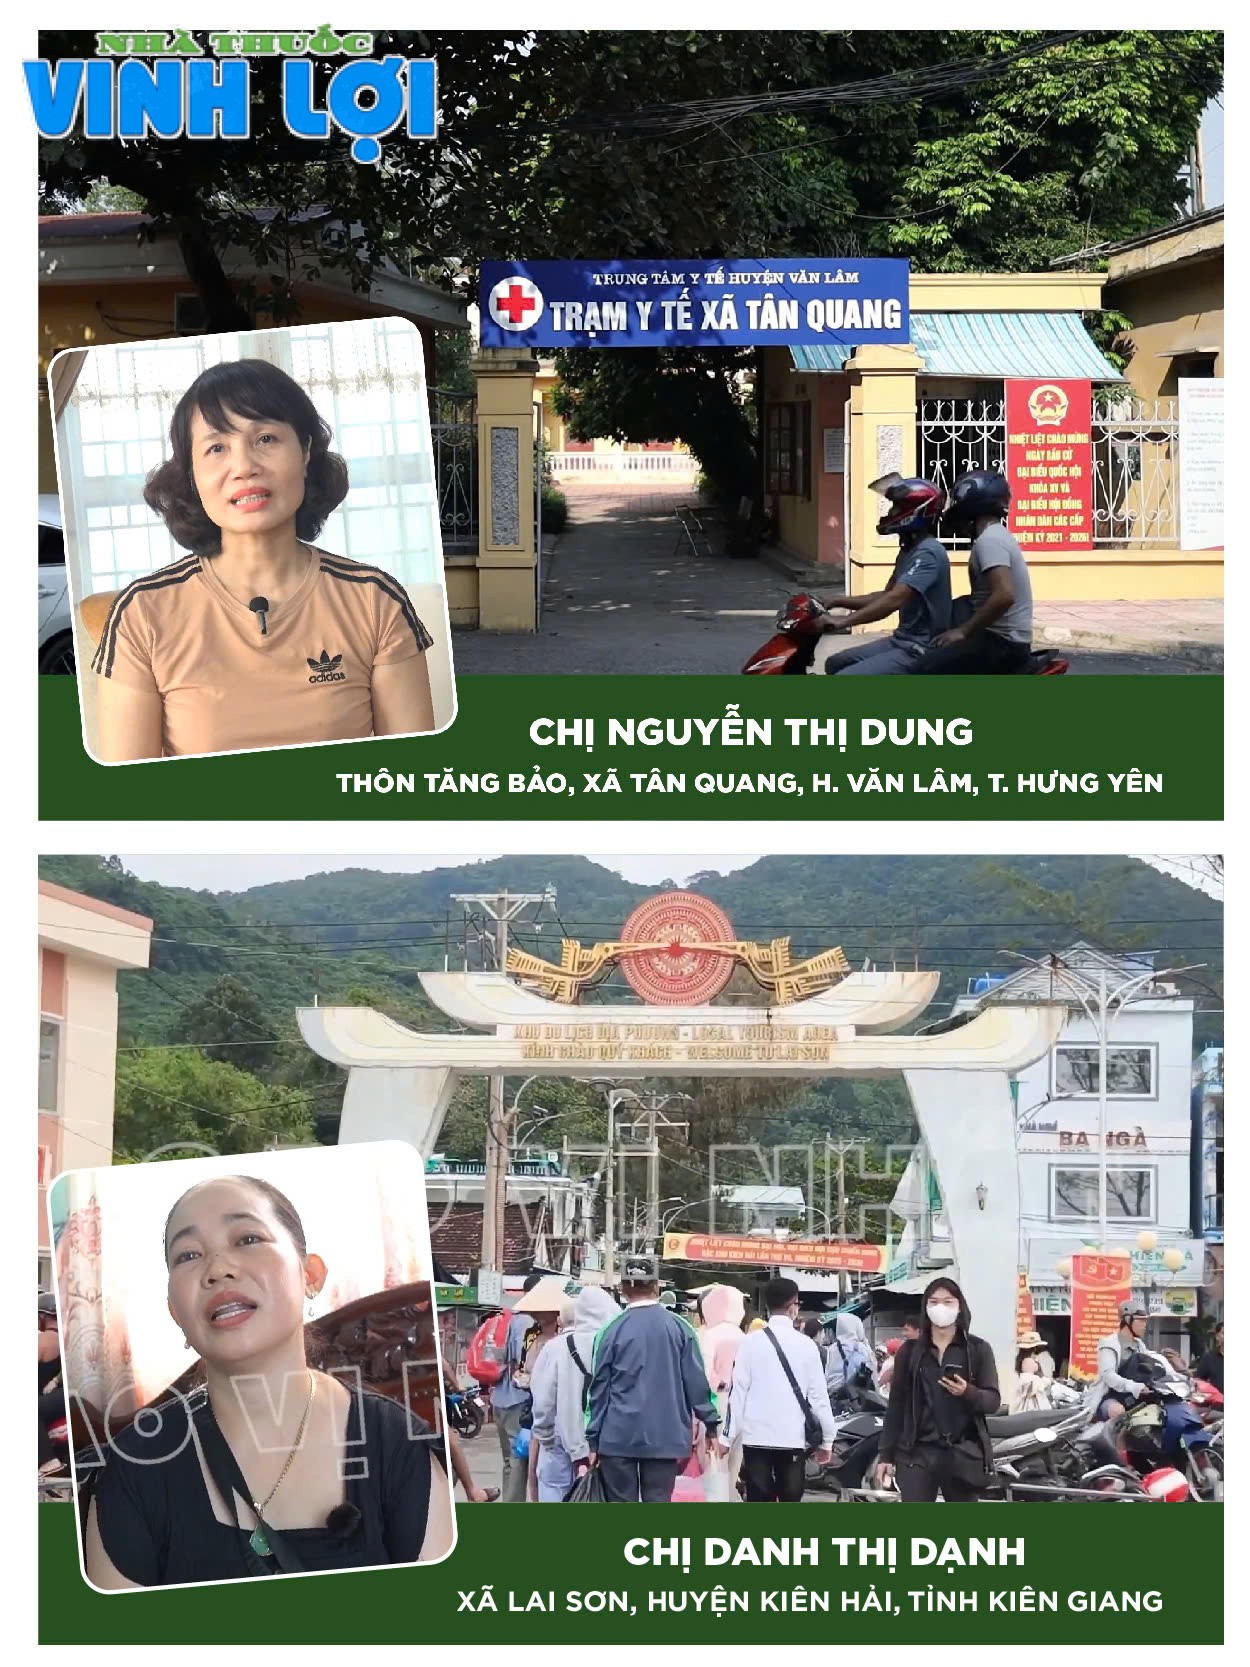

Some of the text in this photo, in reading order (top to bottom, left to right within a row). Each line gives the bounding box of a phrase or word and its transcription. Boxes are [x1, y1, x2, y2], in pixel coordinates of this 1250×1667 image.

[593, 267, 860, 287] TRUNG TÂM Y TẾ HUYỆN VĂN LÂM
[549, 287, 901, 338] TRẠM Y TẾ XÃ TÂN QUANG
[308, 671, 346, 684] adidas
[1059, 1131, 1090, 1147] BA
